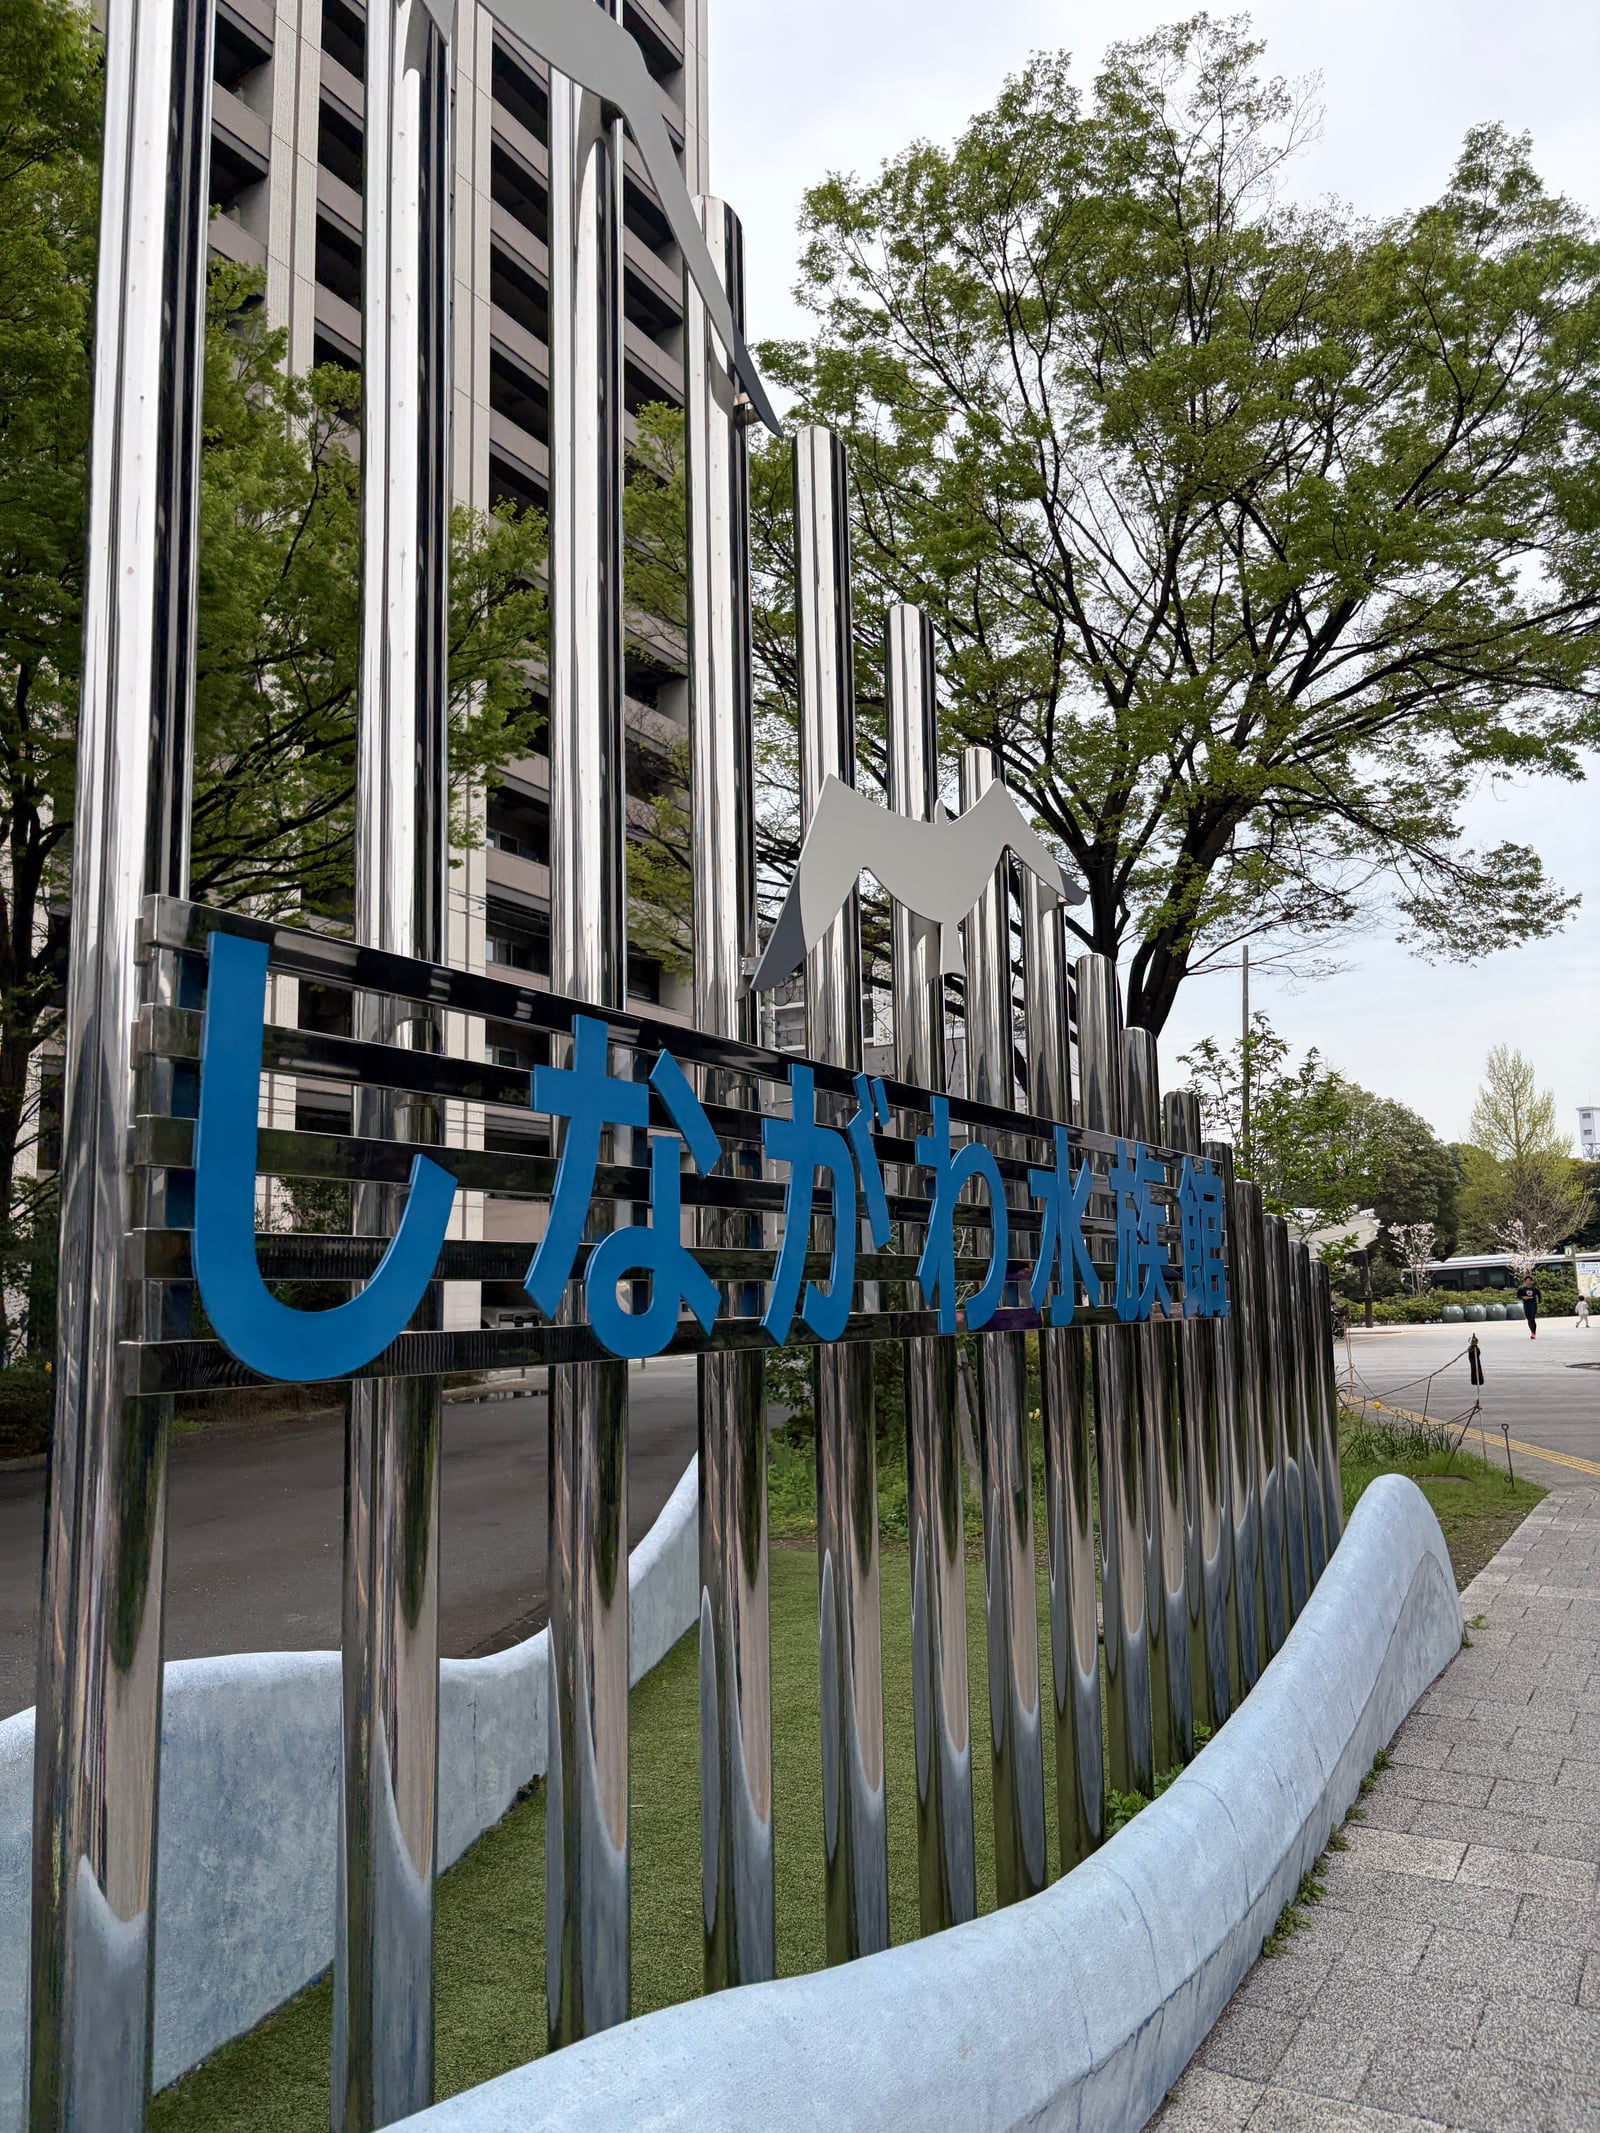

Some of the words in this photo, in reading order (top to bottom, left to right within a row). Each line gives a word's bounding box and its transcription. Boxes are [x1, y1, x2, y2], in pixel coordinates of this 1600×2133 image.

[191, 932, 1230, 1381] しながわ水族館
